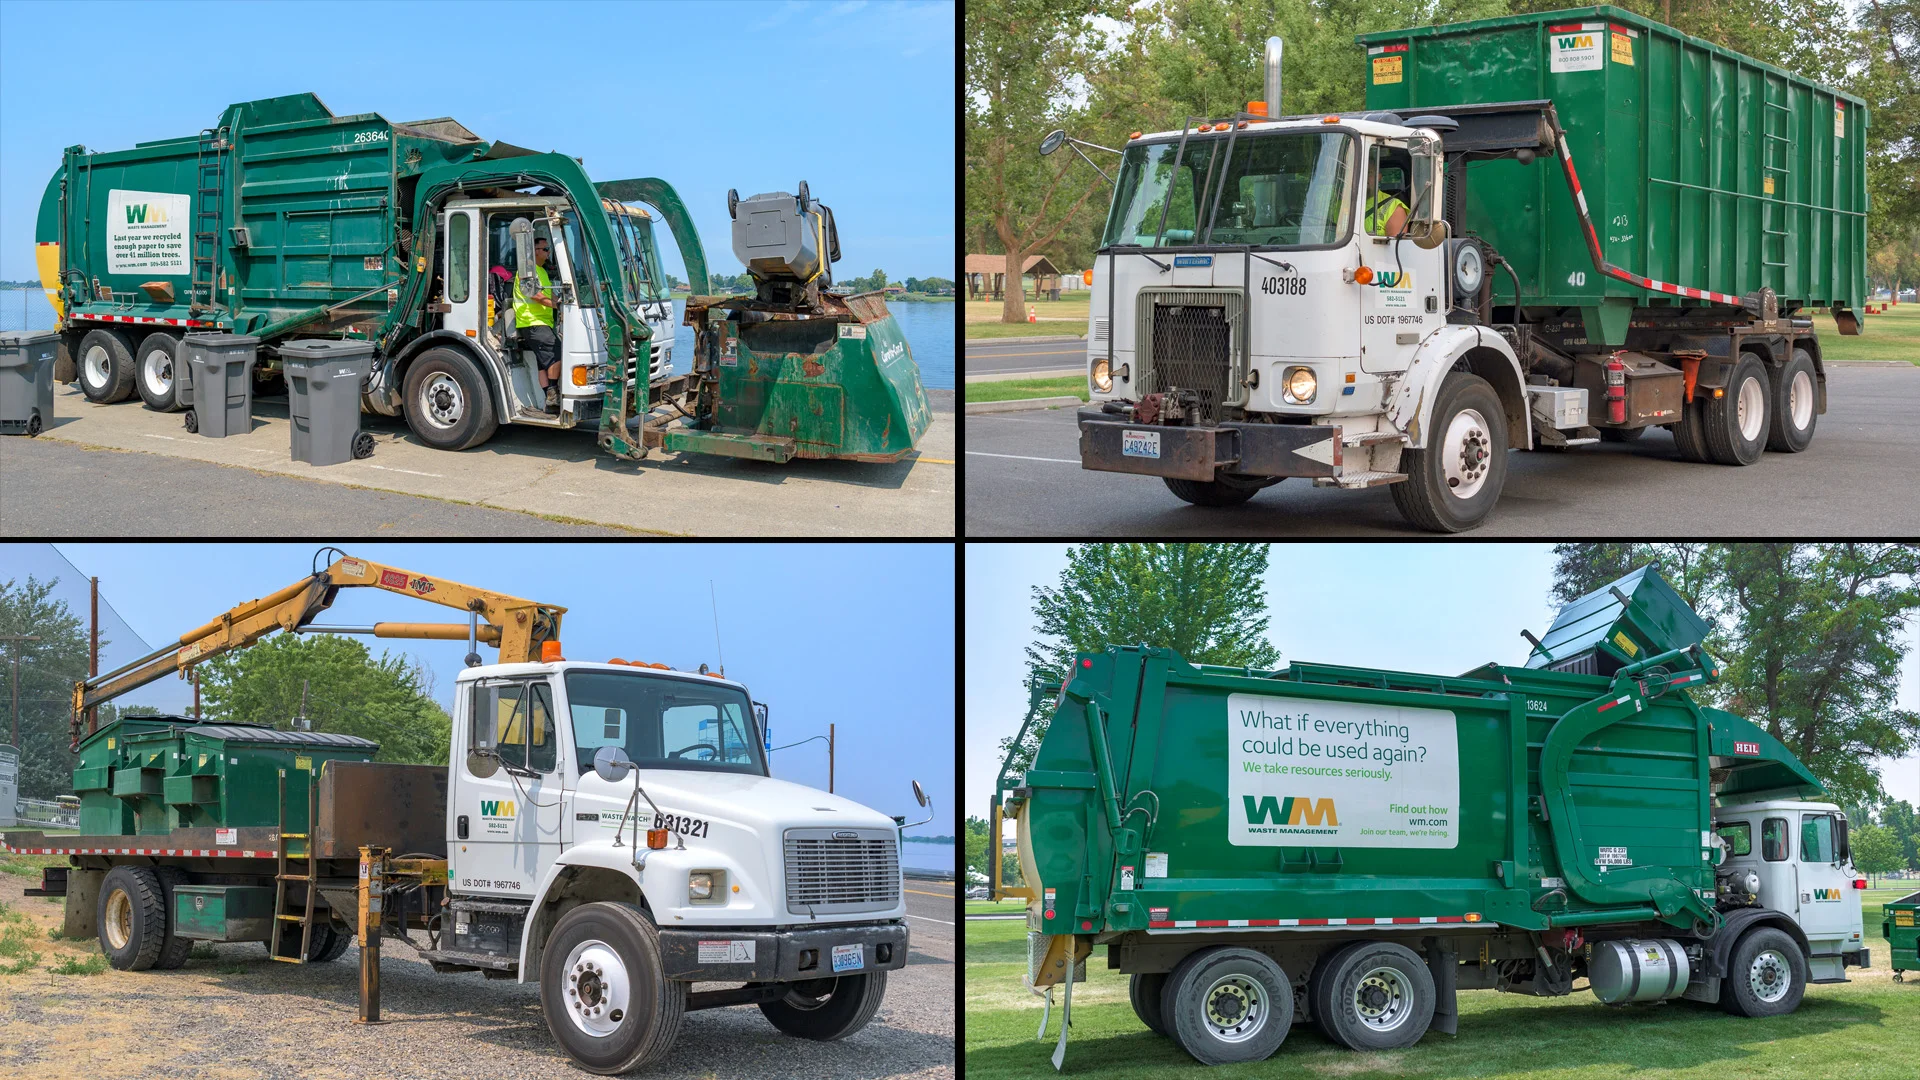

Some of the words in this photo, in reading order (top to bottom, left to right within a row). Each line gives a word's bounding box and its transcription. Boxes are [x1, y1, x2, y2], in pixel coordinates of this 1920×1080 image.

[1558, 35, 1593, 49] WM
[126, 204, 168, 224] WM
[153, 233, 182, 241] recycled
[1261, 276, 1307, 296] 403188
[1377, 271, 1412, 288] WM
[1568, 272, 1586, 286] 40
[1364, 316, 1374, 324] US
[1377, 316, 1395, 324] DOT#
[1398, 316, 1423, 324] 1967746
[1124, 440, 1157, 455] C49242E
[411, 578, 434, 593] IMT
[1526, 700, 1547, 712] 13624
[1240, 710, 1292, 731] What
[1298, 714, 1309, 731] if
[1314, 719, 1409, 743] everything
[1242, 736, 1293, 756] could
[1299, 738, 1321, 757] be
[1326, 742, 1368, 760] used
[1373, 746, 1427, 766] again?
[1736, 744, 1758, 754] HEIL
[1243, 762, 1261, 772] We
[1264, 763, 1288, 775] take
[1290, 766, 1343, 777] resources
[1346, 768, 1393, 782] seriously.
[481, 800, 514, 816] WM
[1242, 795, 1338, 826] WM
[1390, 804, 1409, 814] Find
[1411, 806, 1426, 814] out
[1429, 804, 1448, 814] how
[602, 812, 623, 820] WASTE
[1409, 818, 1448, 826] wm.com
[654, 813, 709, 838] 631321
[1429, 829, 1450, 838] hiring.
[474, 880, 491, 888] DOT#
[494, 880, 520, 890] 1967746
[1814, 888, 1841, 900] WM
